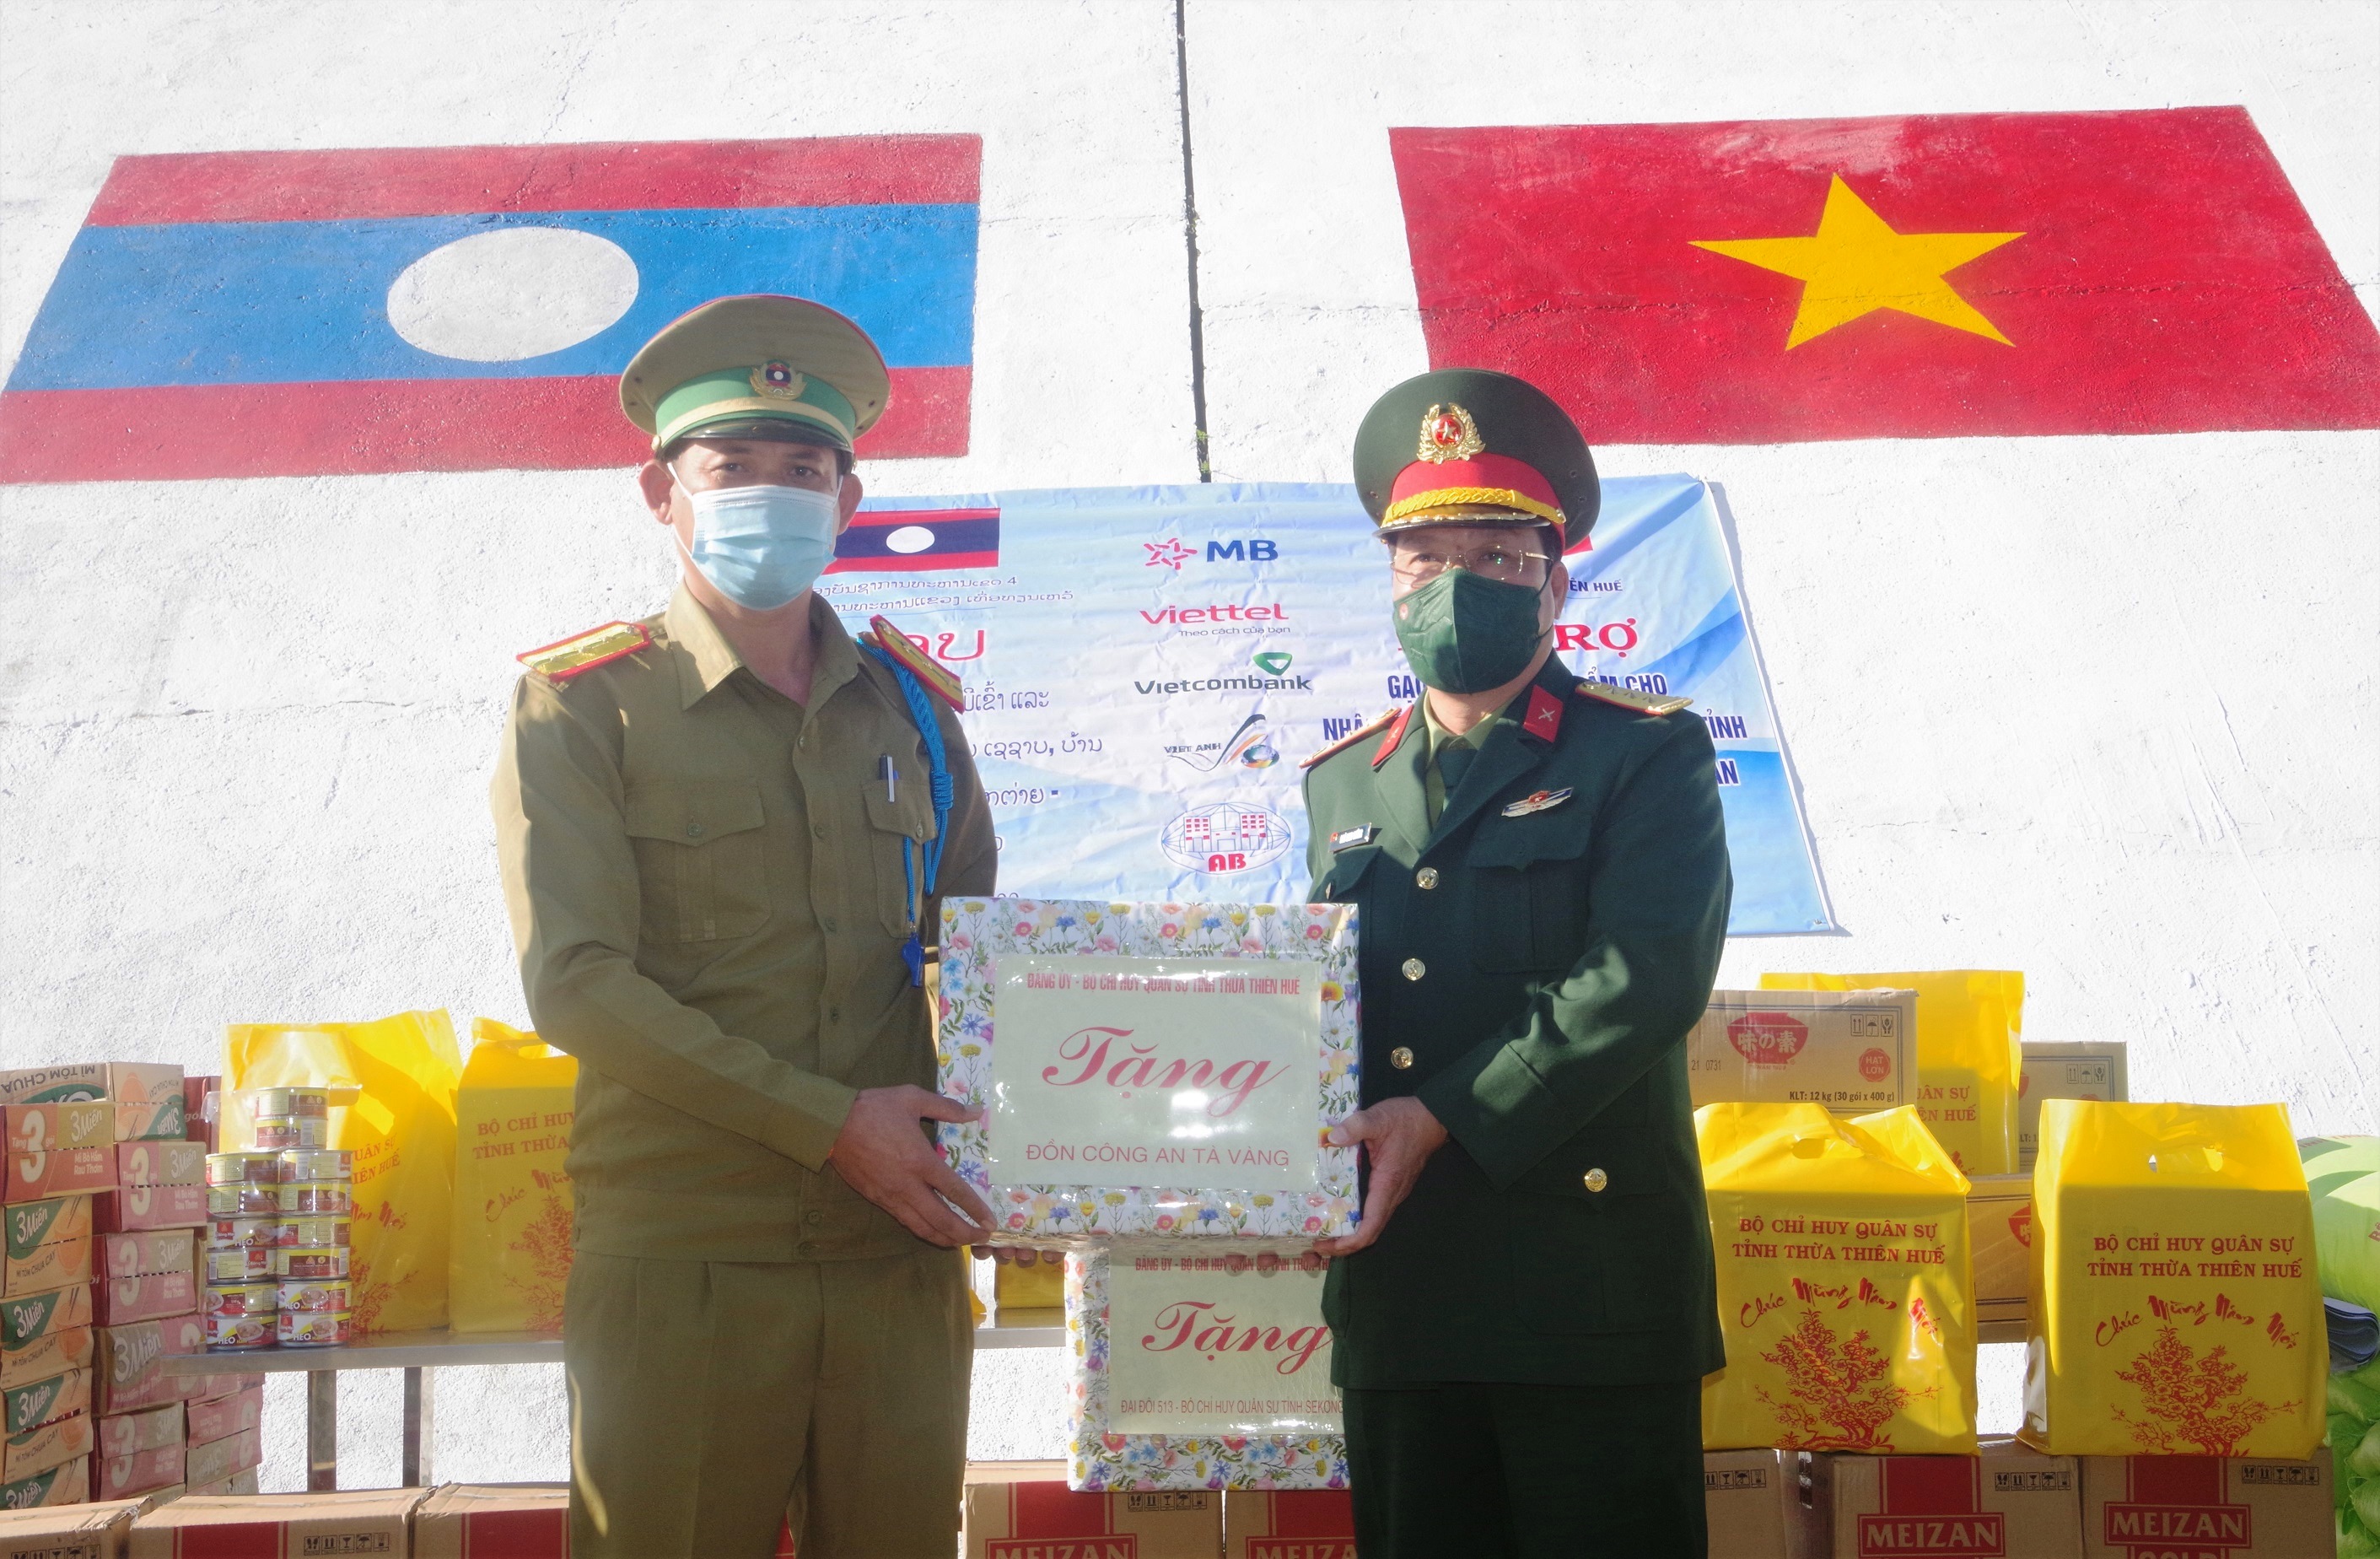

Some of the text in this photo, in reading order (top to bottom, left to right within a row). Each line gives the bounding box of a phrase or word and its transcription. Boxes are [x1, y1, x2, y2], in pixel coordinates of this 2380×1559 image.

[1206, 539, 1279, 563] MB
[1007, 576, 1017, 585] 4
[1593, 578, 1623, 592] HUẾ
[1139, 602, 1290, 624] viettel
[1212, 627, 1241, 635] cách
[1268, 626, 1291, 635] bạn
[1554, 618, 1638, 658] RỢ
[1134, 674, 1312, 695] Vietcombank
[1703, 709, 1747, 738] ỈNH
[1195, 742, 1222, 752] ANH
[1208, 853, 1247, 872] AB
[1737, 1030, 1797, 1054] 味の素
[1042, 1026, 1291, 1118] Tặng
[1705, 1060, 1721, 1071] 0731
[1789, 1092, 1807, 1101] KLT:
[1810, 1091, 1820, 1101] 12
[1822, 1091, 1832, 1102] kg
[1833, 1091, 1848, 1103] (30
[1849, 1091, 1862, 1103] gói
[1870, 1092, 1885, 1101] 400
[1887, 1092, 1895, 1103] g)
[1949, 1085, 1970, 1103] SỰ
[1944, 1103, 1977, 1121] HUẾ
[477, 1118, 500, 1137] BỘ
[507, 1112, 539, 1132] CHỈ
[19, 1109, 46, 1184] 3
[353, 1141, 381, 1163] UÂN
[472, 1141, 516, 1160] TỈNH
[1026, 1138, 1290, 1167] ĐỒN CÔNG AN TÀ VÀNG
[1739, 1214, 1937, 1242] BỘ CHỈ HUY QUÂN SỰ
[234, 1238, 254, 1247] HEO
[1732, 1238, 1946, 1264] TỈNH THỪA THIÊN HUẾ
[2093, 1233, 2295, 1255] BỘ CHỈ HUY QUÂN SỰ
[2087, 1257, 2303, 1278] TỈNH THỪA THIÊN HUẾ
[1740, 1292, 1787, 1329] Chúc
[2096, 1310, 2144, 1347] Chúc
[2147, 1294, 2211, 1326] Mừng
[218, 1336, 236, 1345] HEO
[1141, 1300, 1333, 1375] Tặng
[1120, 1400, 1137, 1416] ĐẠI
[1157, 1400, 1173, 1413] 513
[1181, 1397, 1195, 1416] BỘ
[1215, 1400, 1235, 1414] HUY
[1237, 1398, 1264, 1415] QUÂN
[1866, 1522, 1998, 1548] MEIZAN
[2111, 1512, 2243, 1540] MEIZAN
